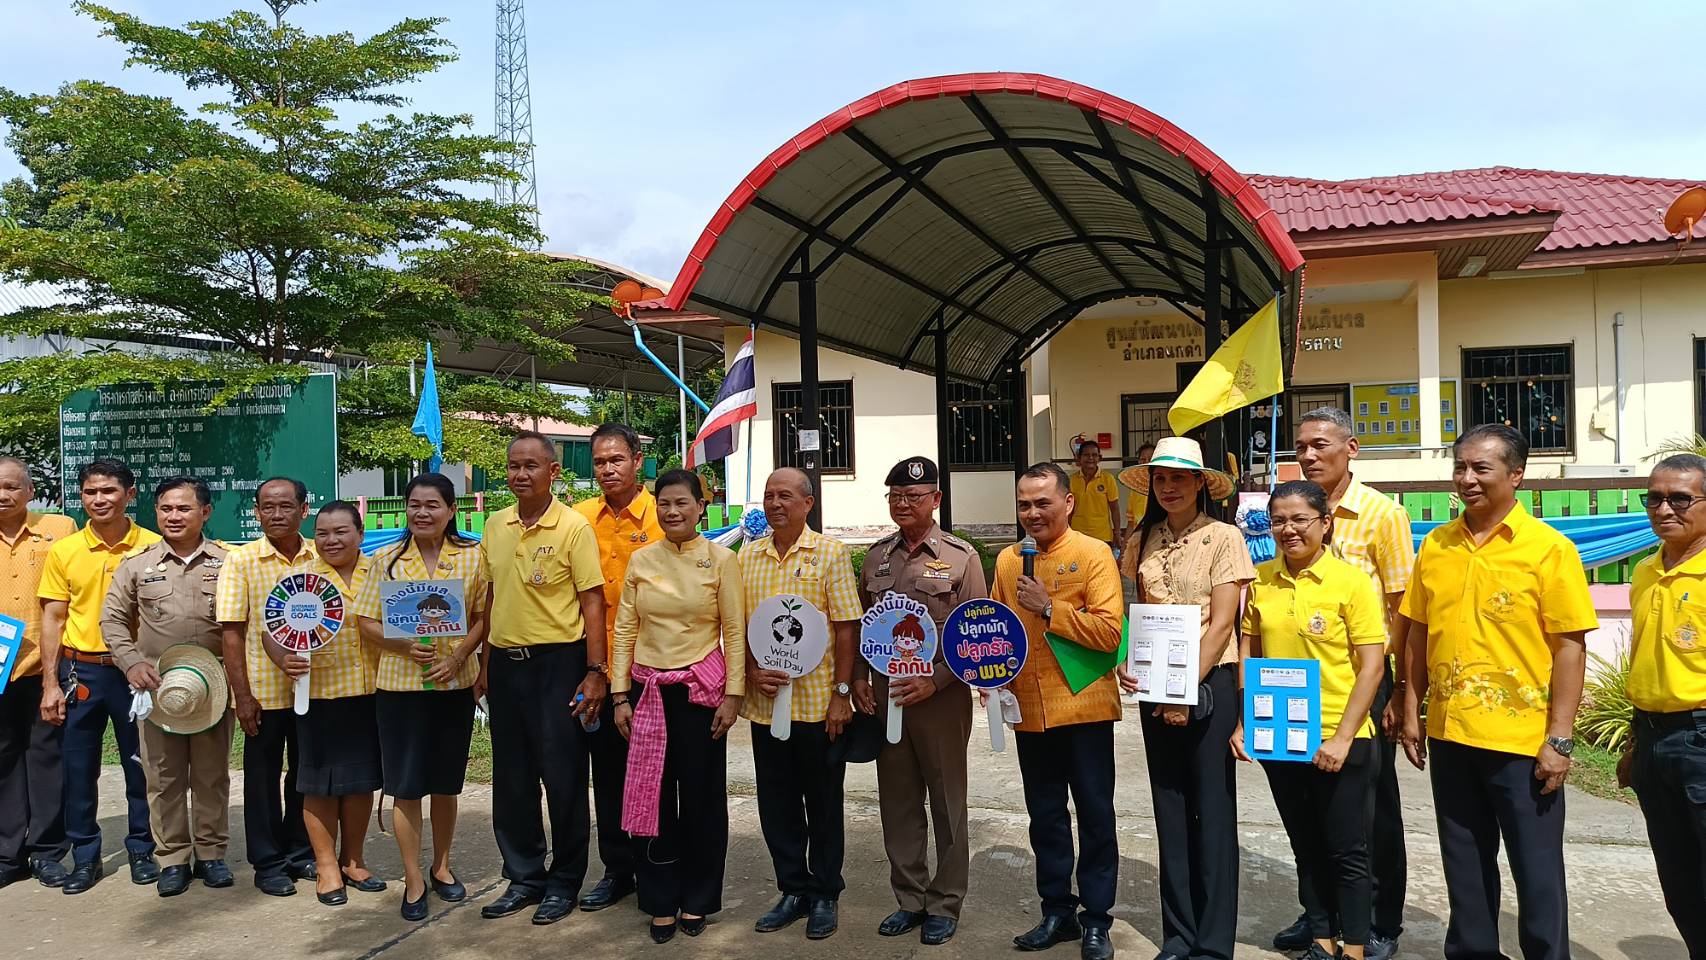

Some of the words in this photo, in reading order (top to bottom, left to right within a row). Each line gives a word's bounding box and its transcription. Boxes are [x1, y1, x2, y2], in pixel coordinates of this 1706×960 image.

[1123, 338, 1203, 361] อำเภอแกดำ
[385, 581, 450, 606] ทางนี้มีผล
[862, 592, 926, 626] ทางนี้มีผล
[964, 605, 996, 620] ปลูกพืช
[387, 613, 421, 627] ผู้คน
[416, 621, 462, 635] รักกัน
[959, 619, 1009, 639] ปลูกผัก
[770, 645, 799, 660] World
[862, 639, 894, 659] ผู้คน
[957, 637, 1014, 663] ปลูกรัก
[764, 656, 782, 668] Soil
[784, 660, 804, 674] Day
[887, 657, 933, 675] รักกัน
[979, 663, 1014, 680] พช.
